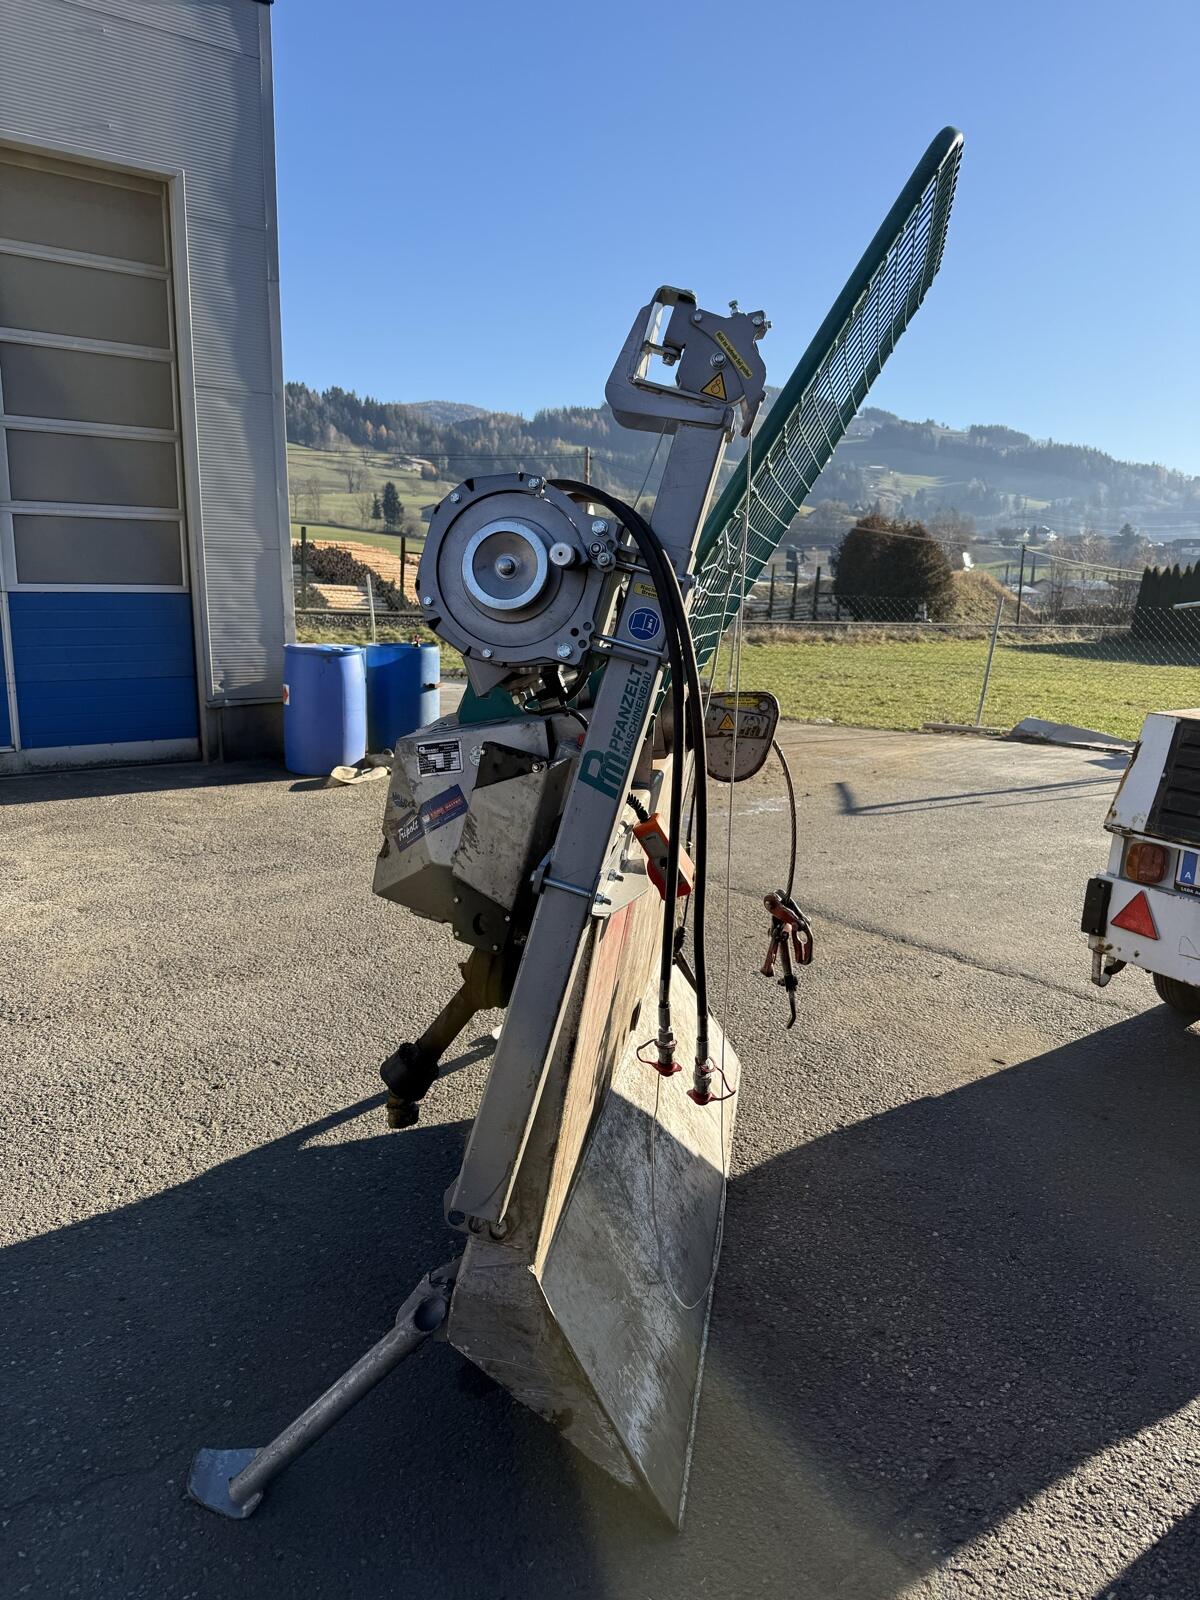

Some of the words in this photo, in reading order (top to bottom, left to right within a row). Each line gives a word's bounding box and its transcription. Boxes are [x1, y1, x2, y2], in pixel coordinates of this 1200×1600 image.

[609, 664, 643, 752] PFANZELT
[622, 672, 652, 758] MASCHINENBAU
[1184, 871, 1192, 880] A
